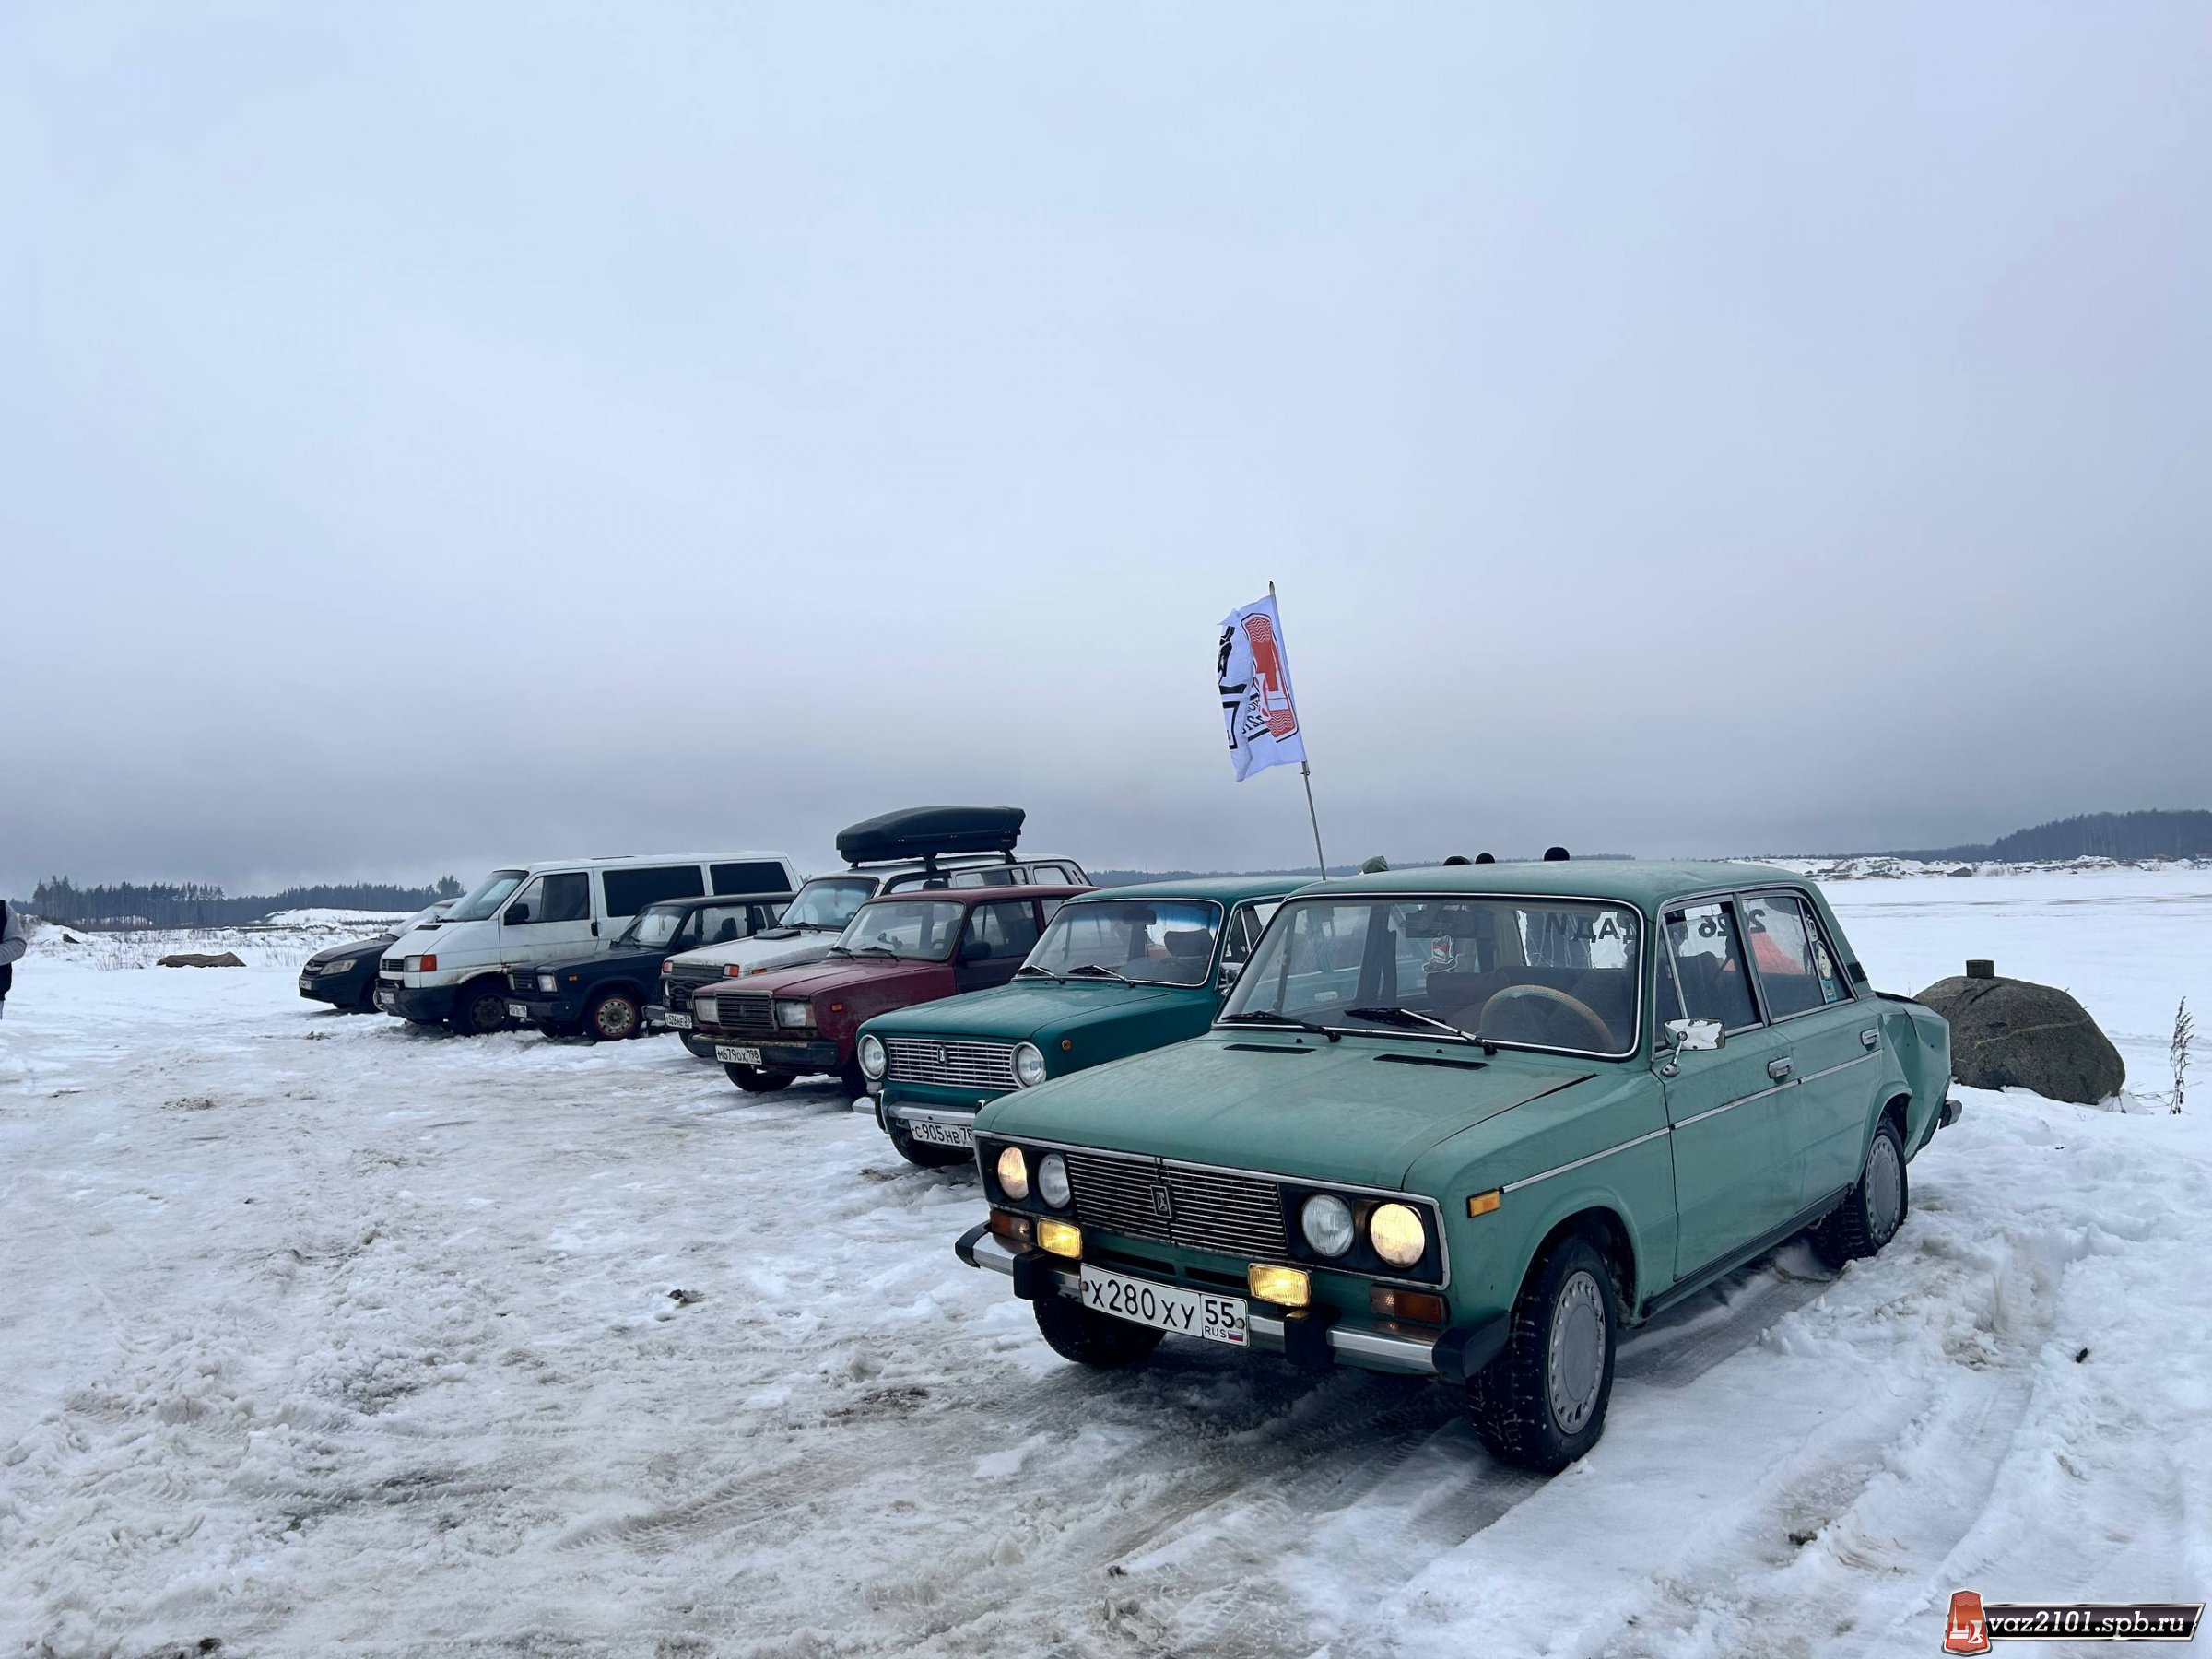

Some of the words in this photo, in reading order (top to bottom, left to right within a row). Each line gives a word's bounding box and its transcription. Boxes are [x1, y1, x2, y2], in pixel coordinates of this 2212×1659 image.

[914, 1124, 960, 1144] С905НВ
[1090, 1279, 1194, 1330] Х280ХУ
[1205, 1299, 1236, 1329] 55
[1205, 1325, 1227, 1338] RUS
